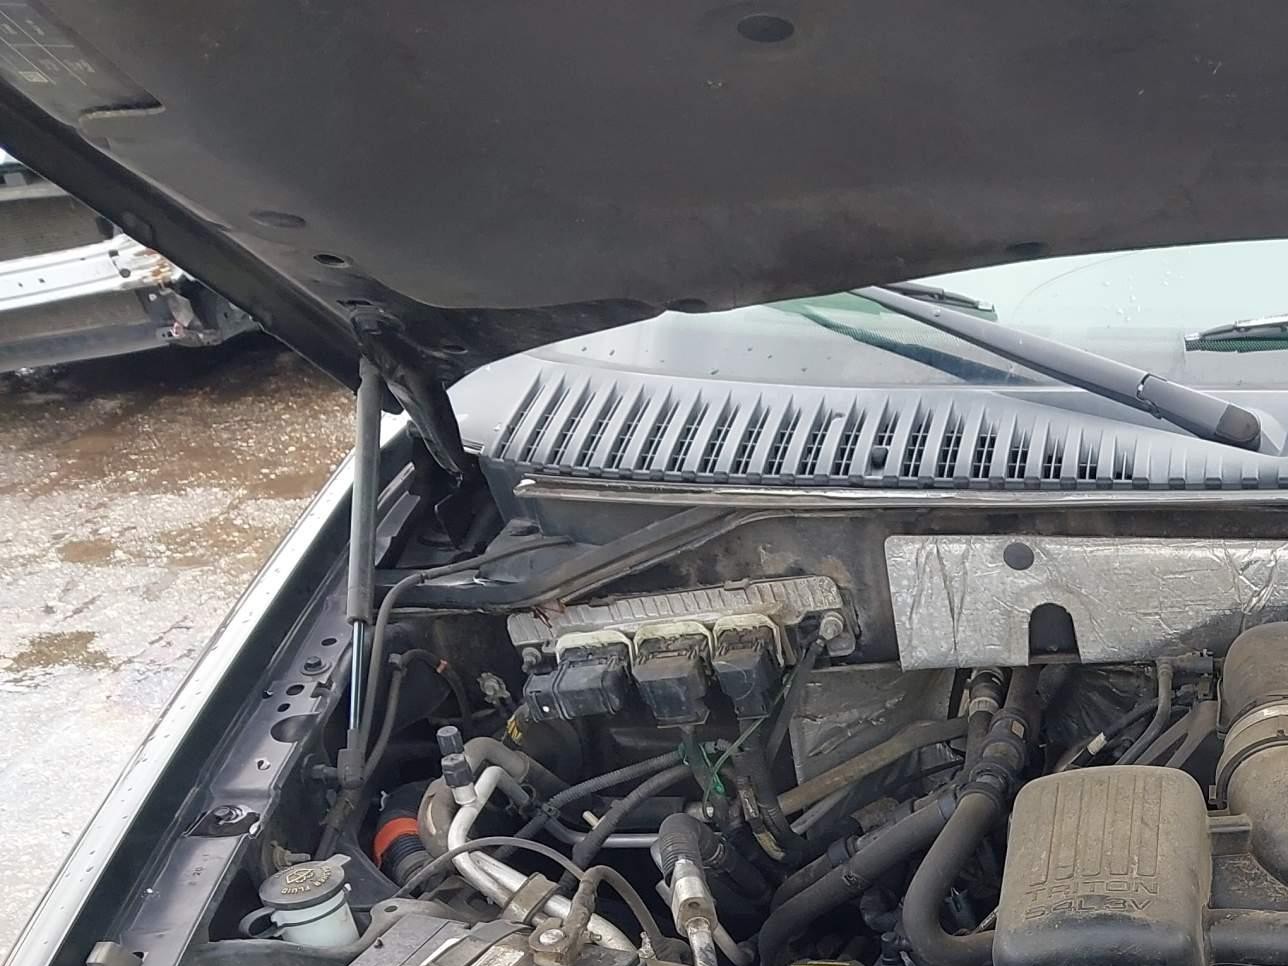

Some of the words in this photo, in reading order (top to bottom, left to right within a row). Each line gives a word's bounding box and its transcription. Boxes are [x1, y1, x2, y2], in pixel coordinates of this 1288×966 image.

[281, 884, 311, 895] FLUID
[1025, 880, 1159, 902] TRITON
[1103, 897, 1151, 912] 3V
